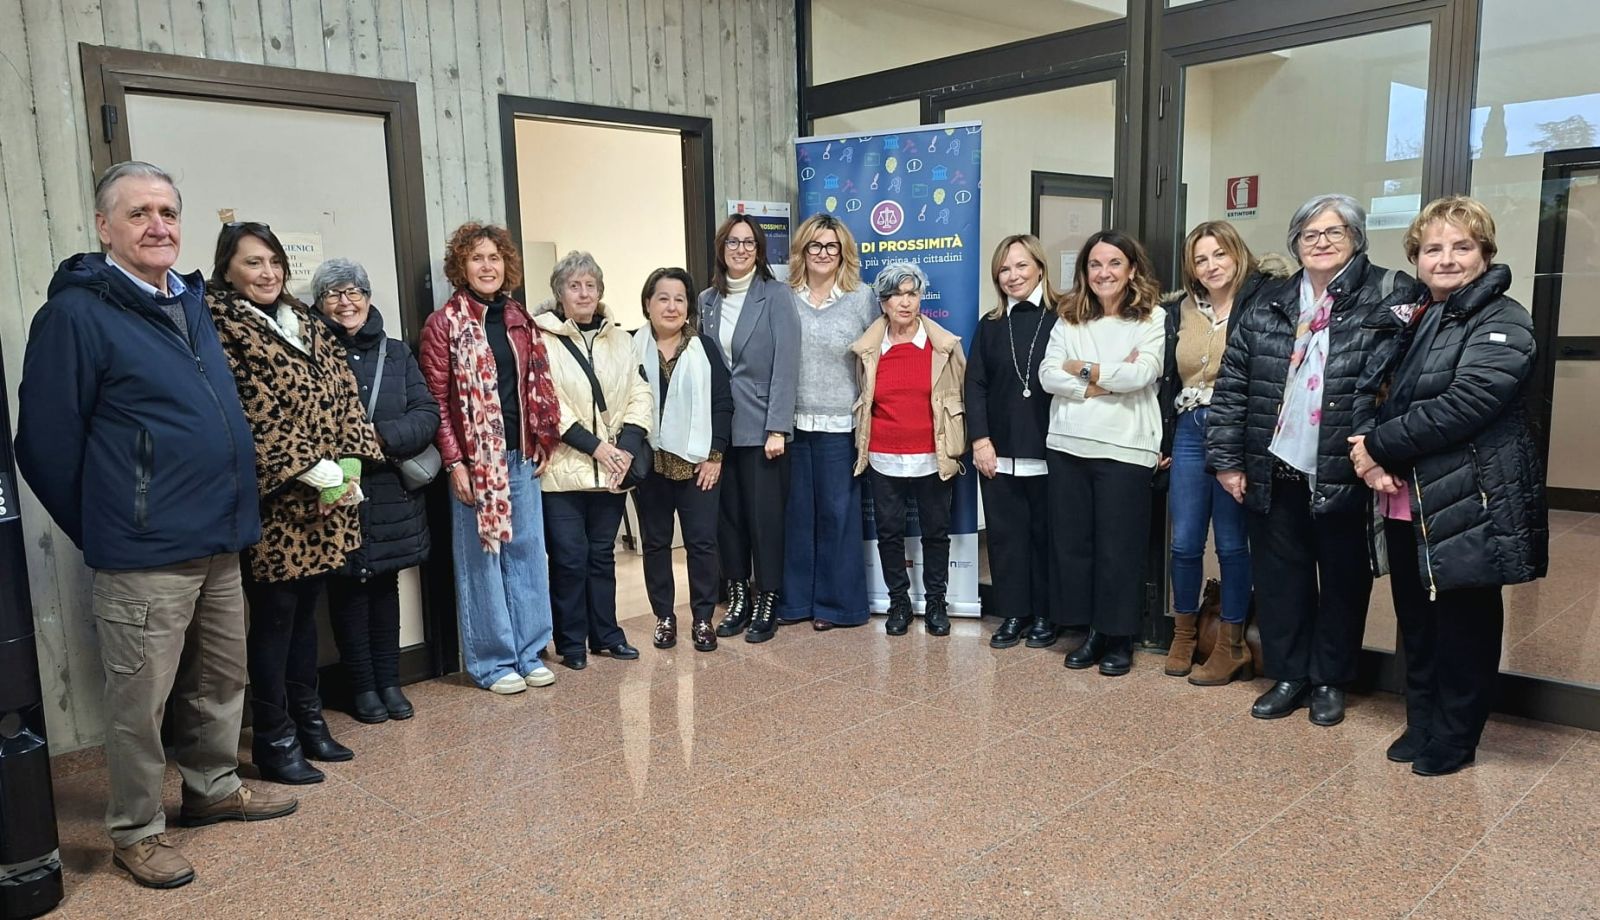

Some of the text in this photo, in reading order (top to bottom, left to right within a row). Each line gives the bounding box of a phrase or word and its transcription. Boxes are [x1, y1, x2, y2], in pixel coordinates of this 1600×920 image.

[861, 242, 875, 253] DI
[879, 233, 963, 252] PROSSIMITÀ
[865, 256, 879, 269] più
[911, 254, 921, 264] ai
[923, 252, 963, 264] cittadini
[922, 291, 941, 300] adini
[920, 308, 950, 318] fficio
